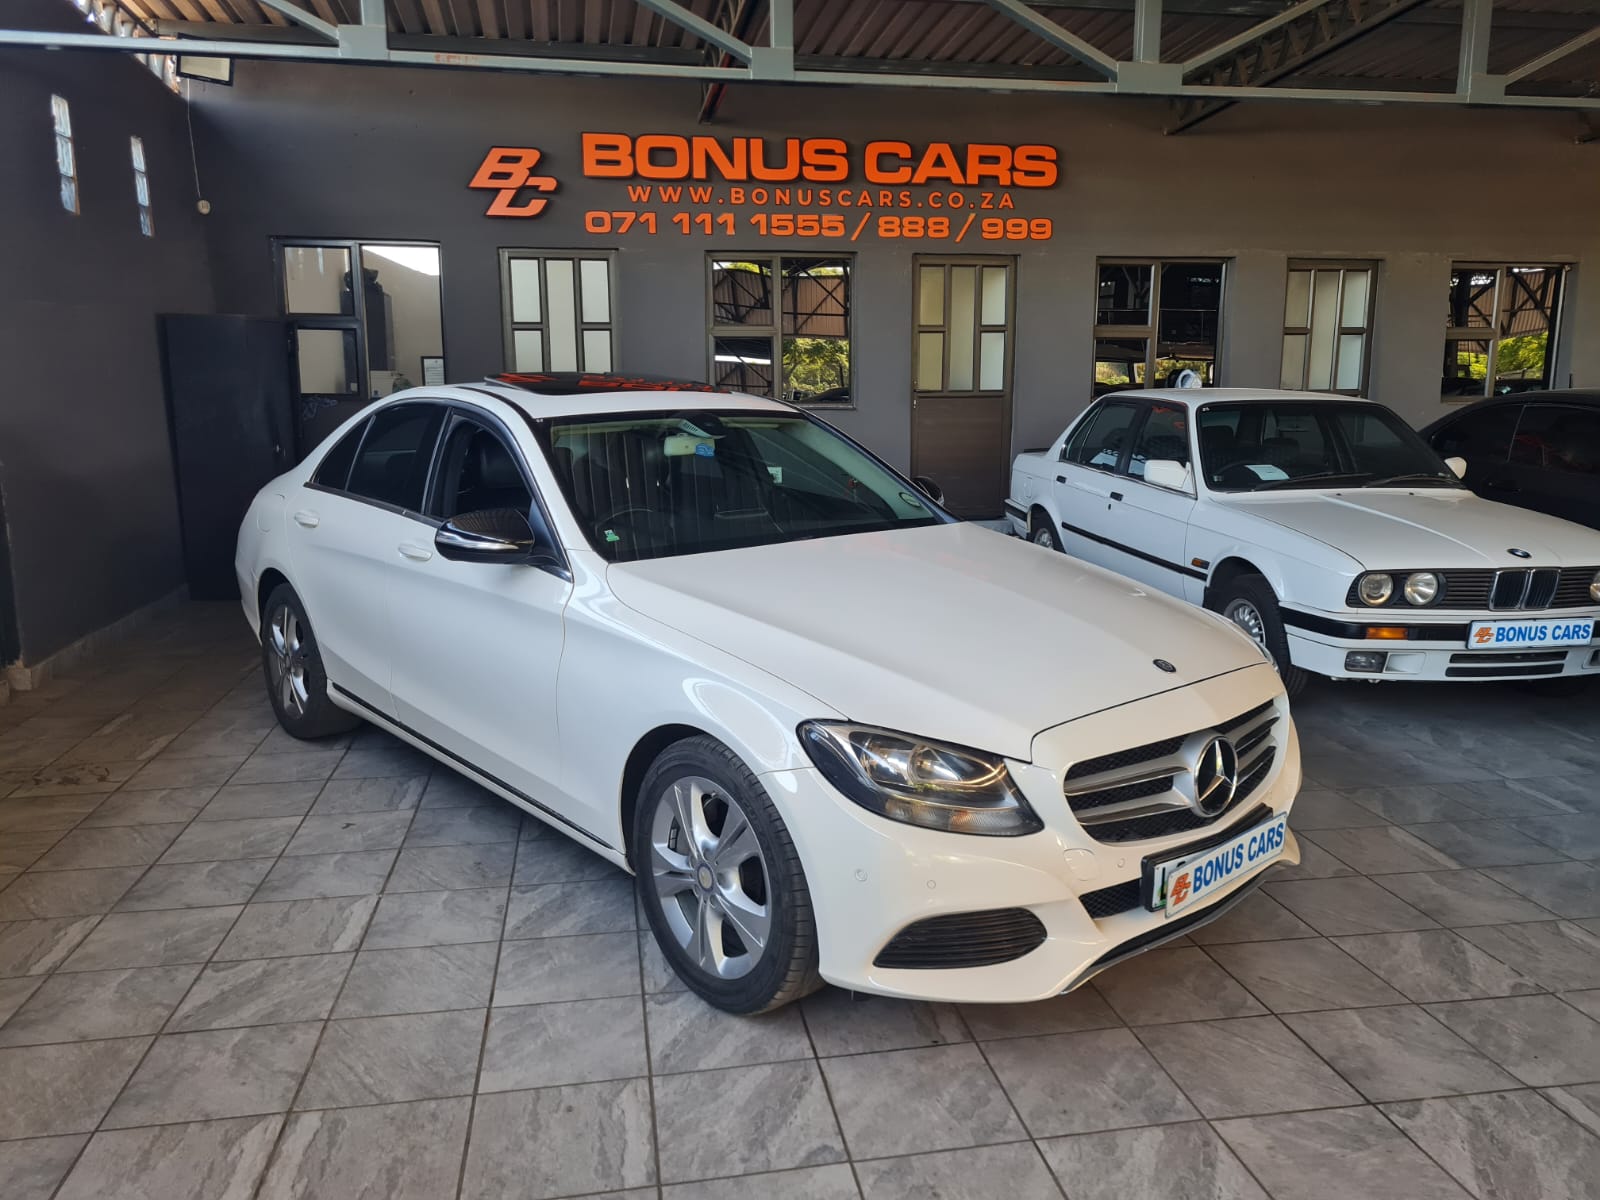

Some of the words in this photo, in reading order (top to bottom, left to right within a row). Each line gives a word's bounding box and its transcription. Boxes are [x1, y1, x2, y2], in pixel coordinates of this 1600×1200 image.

[581, 132, 849, 182] BONUS
[864, 141, 1058, 188] CARS
[468, 146, 558, 217] BC
[626, 185, 1014, 209] WWW.BONUSCARS.CO.ZA
[583, 210, 657, 236] 071
[671, 211, 736, 236] 111
[1495, 625, 1548, 643] BONUS
[1552, 623, 1591, 641] CARS
[1193, 843, 1244, 893] BONUS
[1247, 822, 1285, 862] CARS
